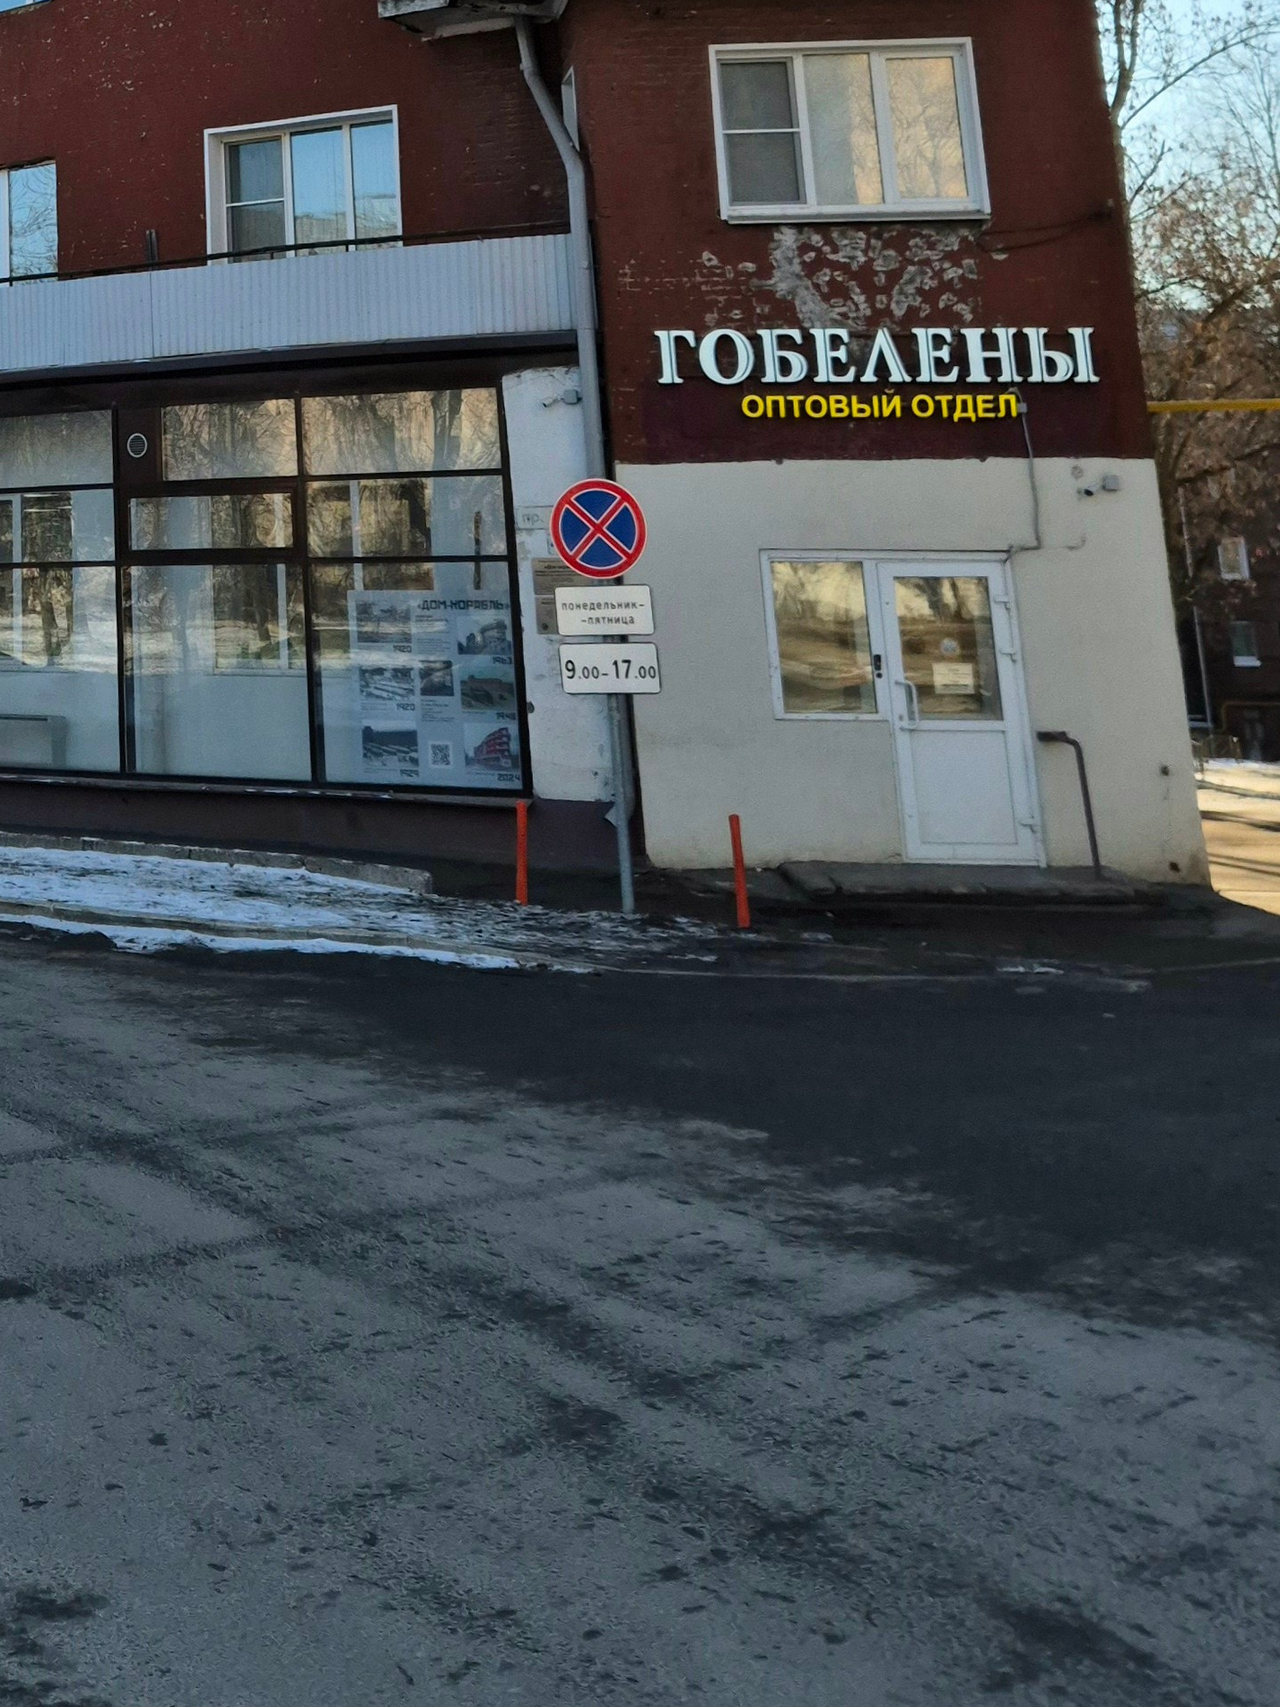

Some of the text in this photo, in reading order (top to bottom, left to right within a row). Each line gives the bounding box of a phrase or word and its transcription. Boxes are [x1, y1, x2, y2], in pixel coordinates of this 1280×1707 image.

[653, 326, 1100, 385] ГОБЕЛЕНЫ
[741, 387, 1019, 424] ОПТОВЫЙ ОТДЕЛ
[561, 601, 645, 612] понедельник-
[581, 615, 635, 625] -пятница
[564, 659, 657, 680] 9.00-17.00
[497, 773, 521, 781] 2024
